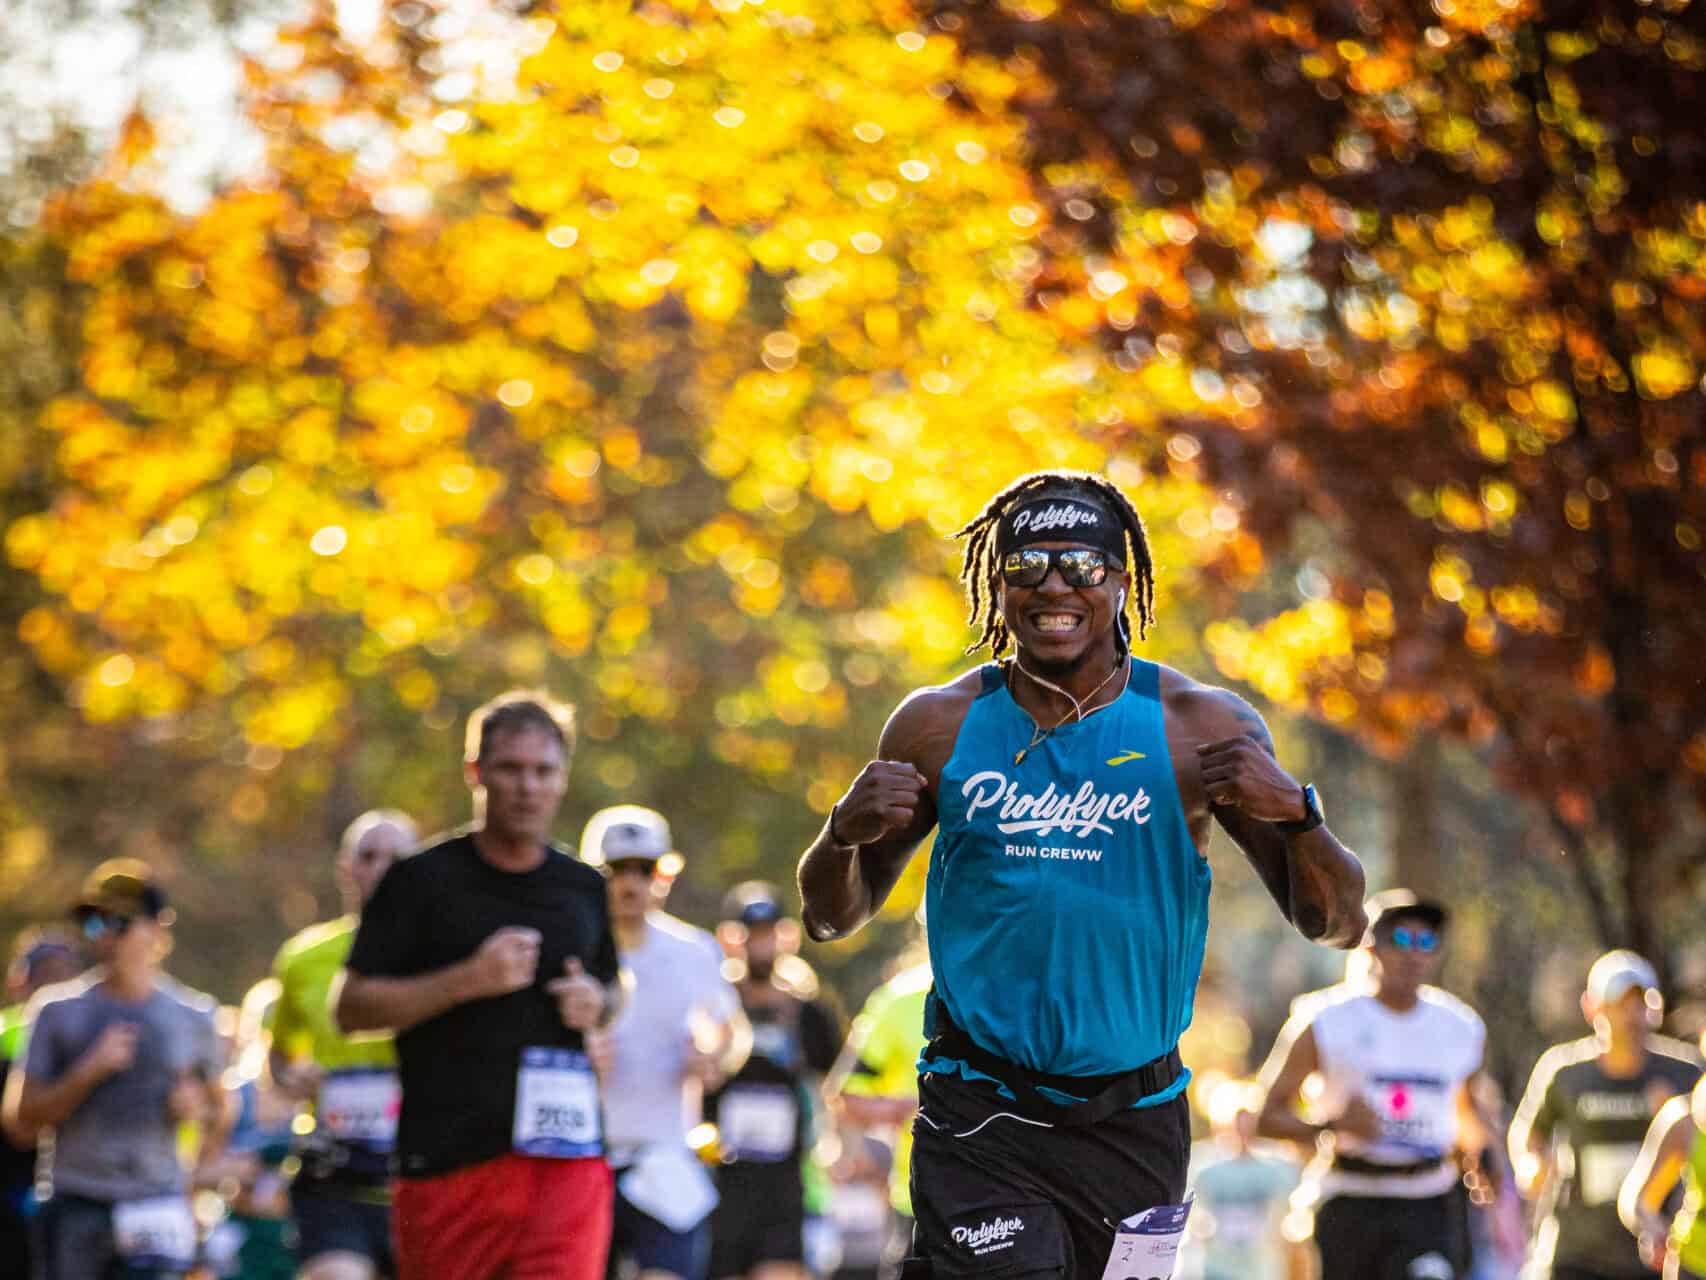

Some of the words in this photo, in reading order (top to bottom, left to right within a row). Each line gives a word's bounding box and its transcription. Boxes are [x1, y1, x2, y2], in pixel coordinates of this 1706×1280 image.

[962, 771, 1151, 838] Prolyfyck
[1005, 844, 1037, 858] RUN
[1040, 847, 1103, 861] CREWW
[951, 1216, 1025, 1248] Prolyfyck
